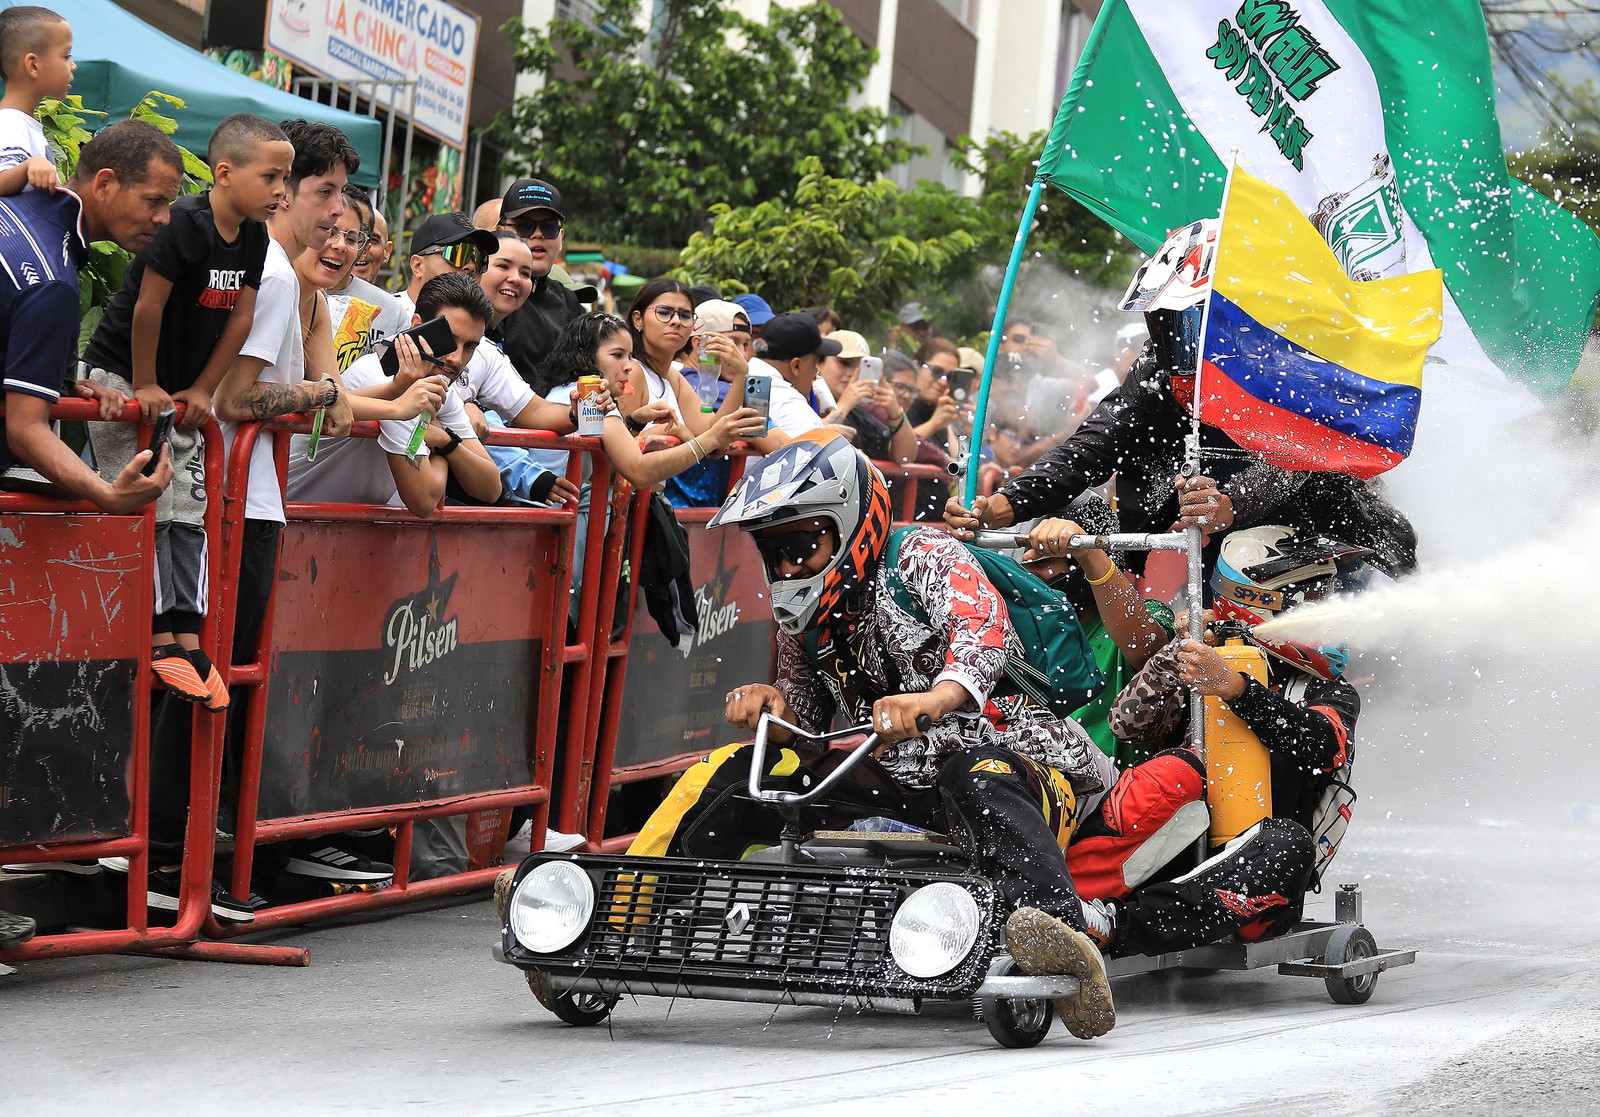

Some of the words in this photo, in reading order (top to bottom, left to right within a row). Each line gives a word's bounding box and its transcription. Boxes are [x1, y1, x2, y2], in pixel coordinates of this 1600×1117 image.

[325, 0, 348, 36] LA
[353, 10, 419, 74] CHINCA
[1206, 18, 1250, 81] SOY
[1235, 52, 1273, 117] DEL
[1263, 25, 1341, 102] FELIZ
[1234, 586, 1260, 602] SPY
[384, 599, 458, 686] Pilsen
